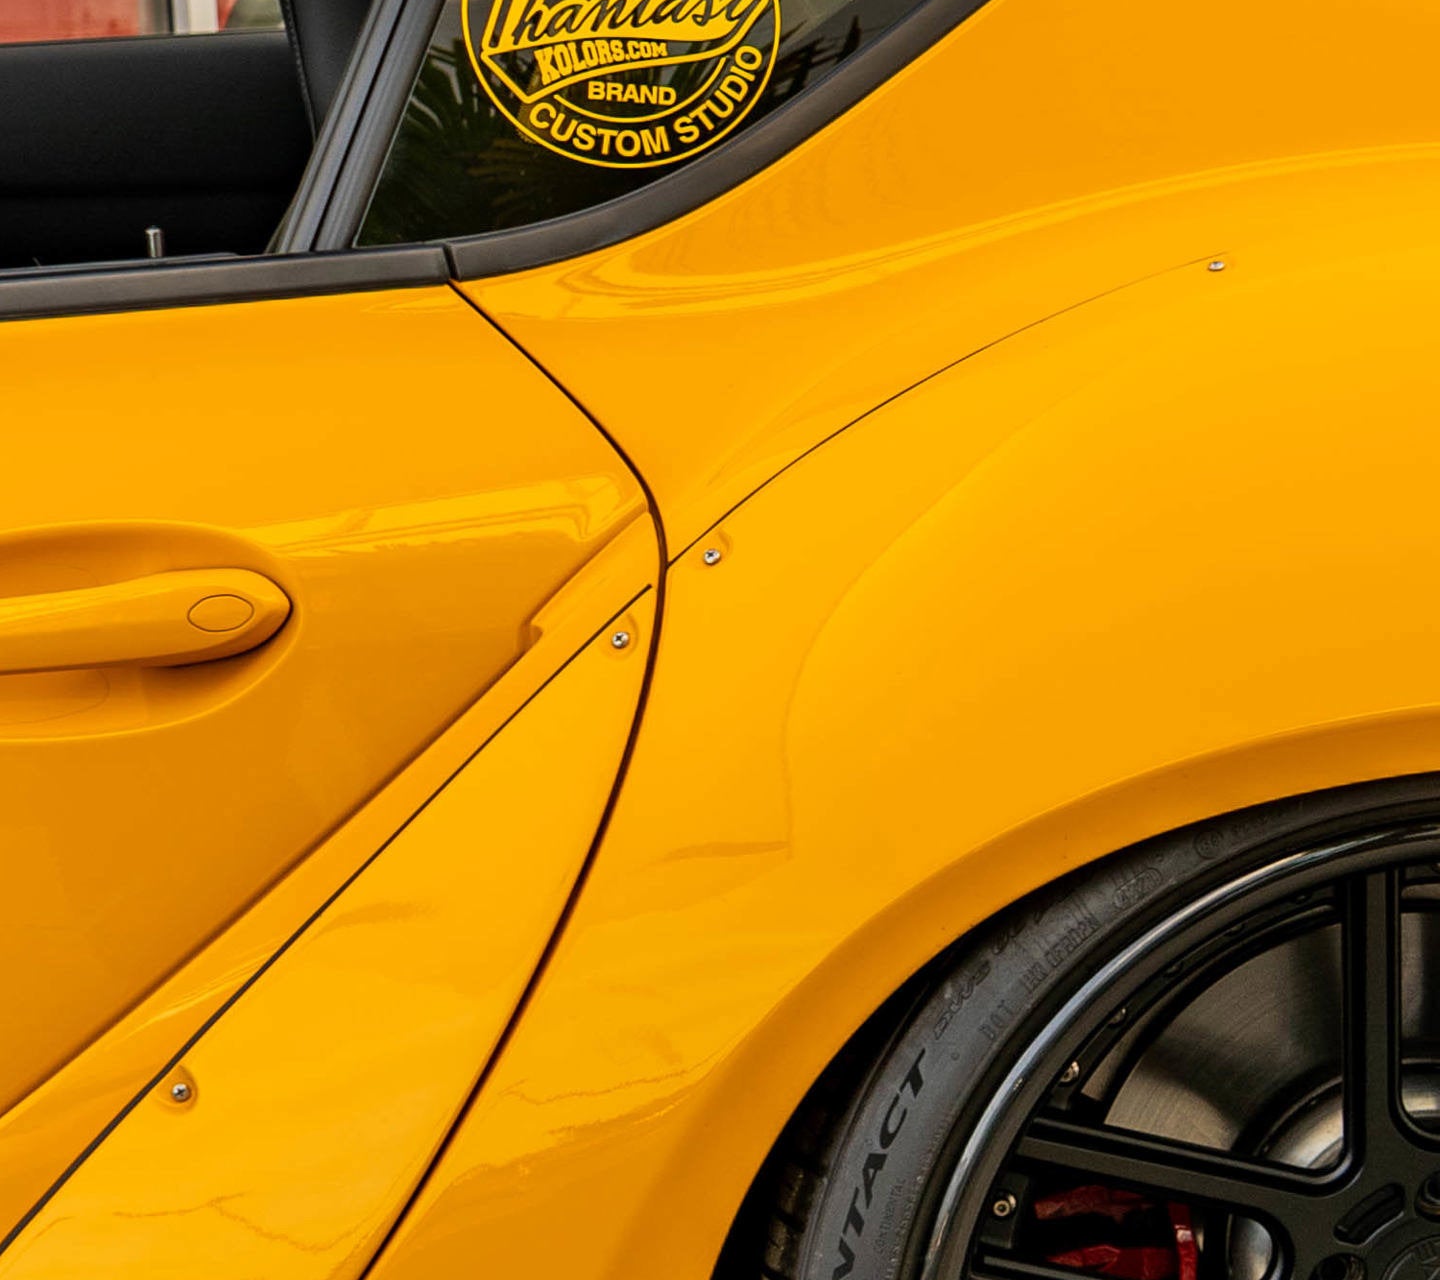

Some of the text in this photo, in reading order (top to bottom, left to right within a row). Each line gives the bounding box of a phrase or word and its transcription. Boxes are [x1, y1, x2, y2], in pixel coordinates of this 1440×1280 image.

[533, 39, 669, 86] KOLORS.COM
[529, 45, 763, 157] CUSTOM STUDIO
[587, 81, 677, 106] BRAND
